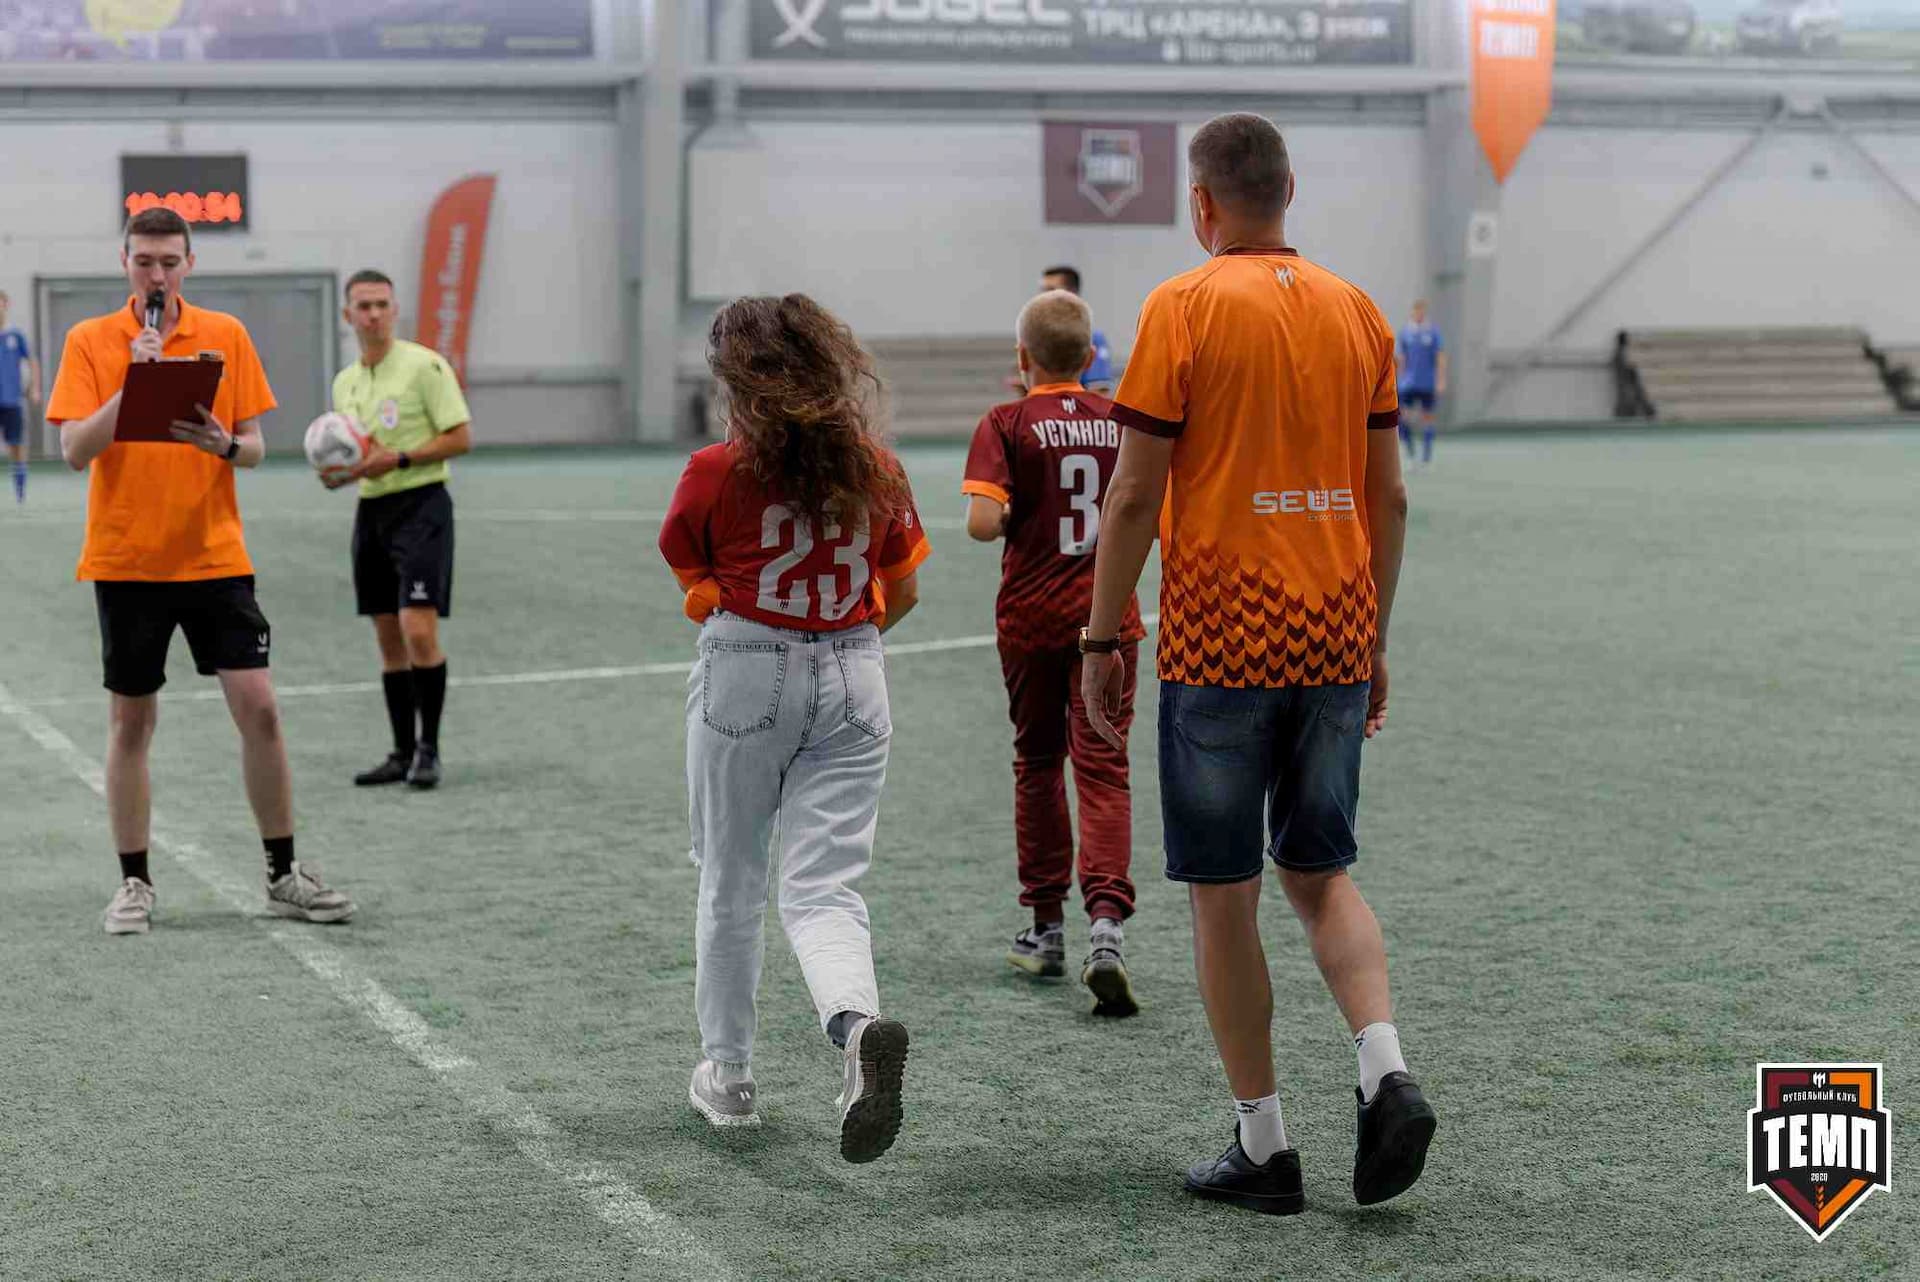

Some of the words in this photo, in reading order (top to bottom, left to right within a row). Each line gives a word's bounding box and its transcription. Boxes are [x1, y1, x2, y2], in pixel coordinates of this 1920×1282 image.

[1031, 418, 1120, 449] УСТИНОВ
[1058, 454, 1100, 556] 3
[1253, 488, 1354, 513] SEUS
[756, 503, 871, 621] 23
